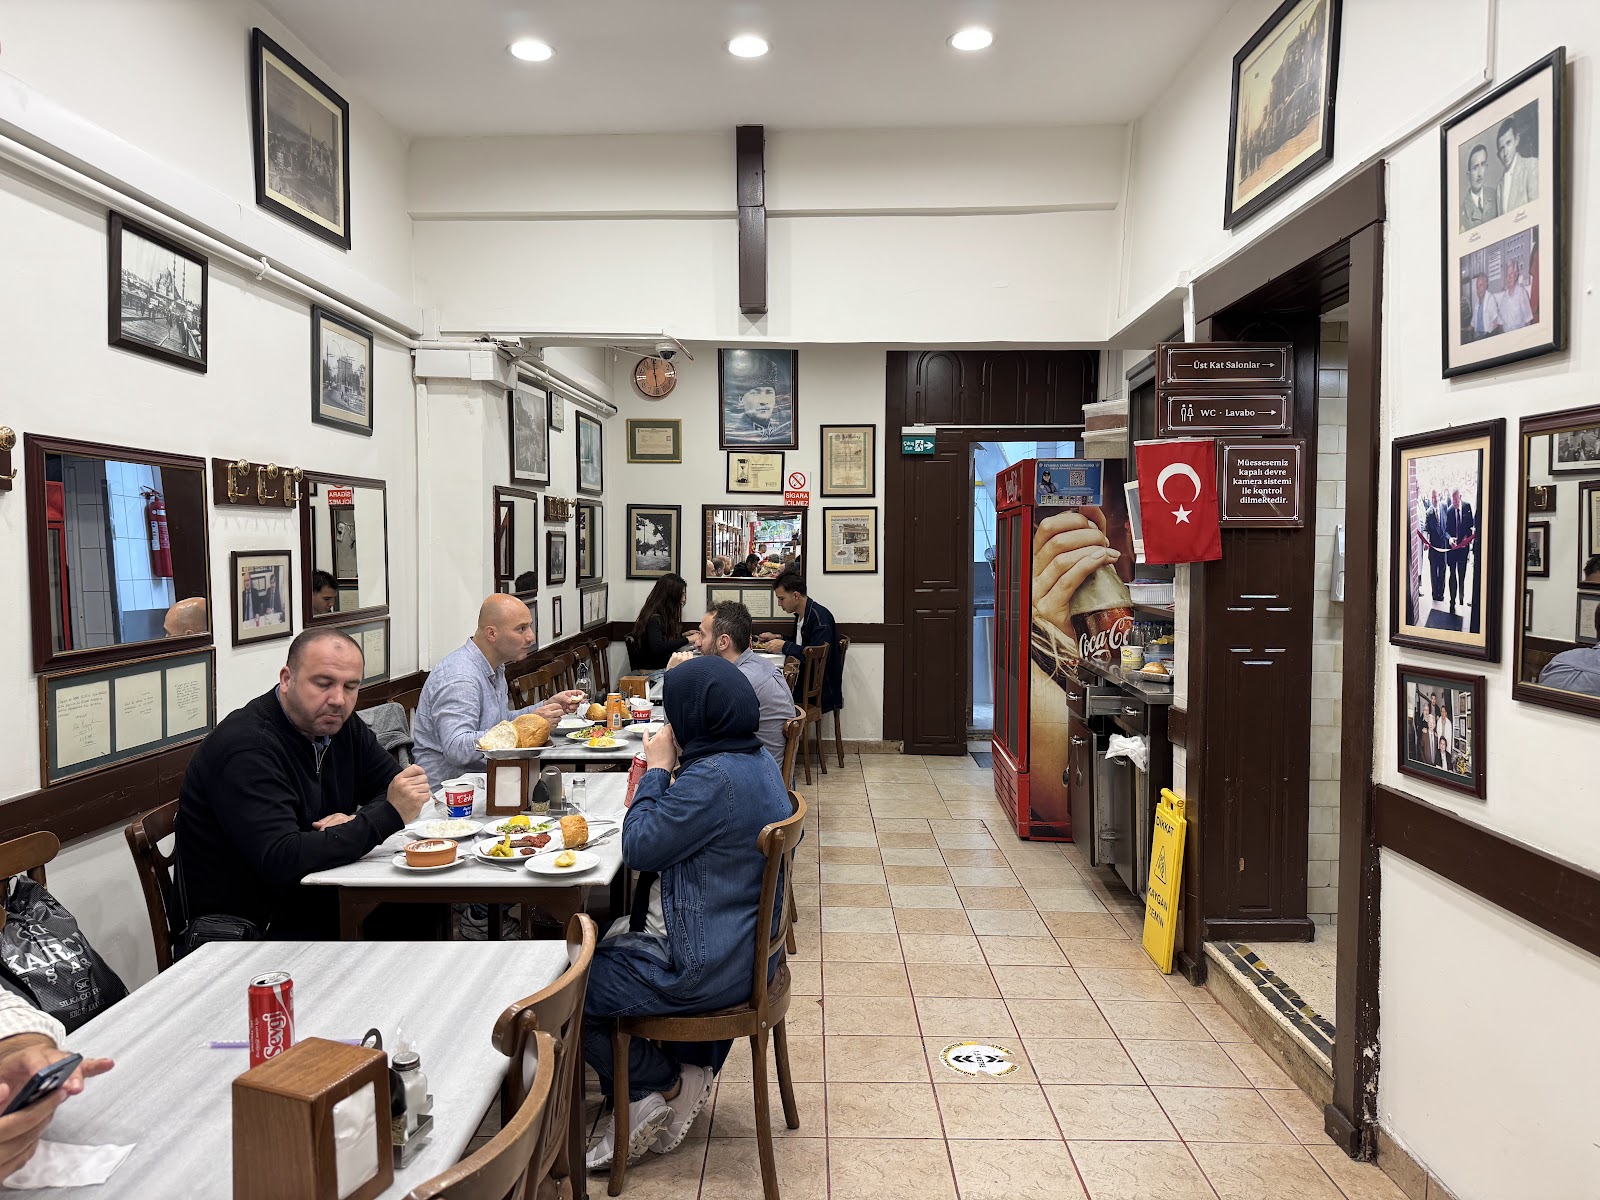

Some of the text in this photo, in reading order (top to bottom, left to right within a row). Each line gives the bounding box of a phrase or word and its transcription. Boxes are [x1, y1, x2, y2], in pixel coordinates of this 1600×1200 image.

[1193, 360, 1261, 369] Üst Kat Salonlar
[1200, 409, 1255, 417] WC Lavabo
[1238, 469, 1263, 477] kapalı
[1240, 496, 1289, 504] dilmektedir.
[1155, 816, 1175, 837] DİKKAT
[262, 1011, 287, 1060] Sevgi
